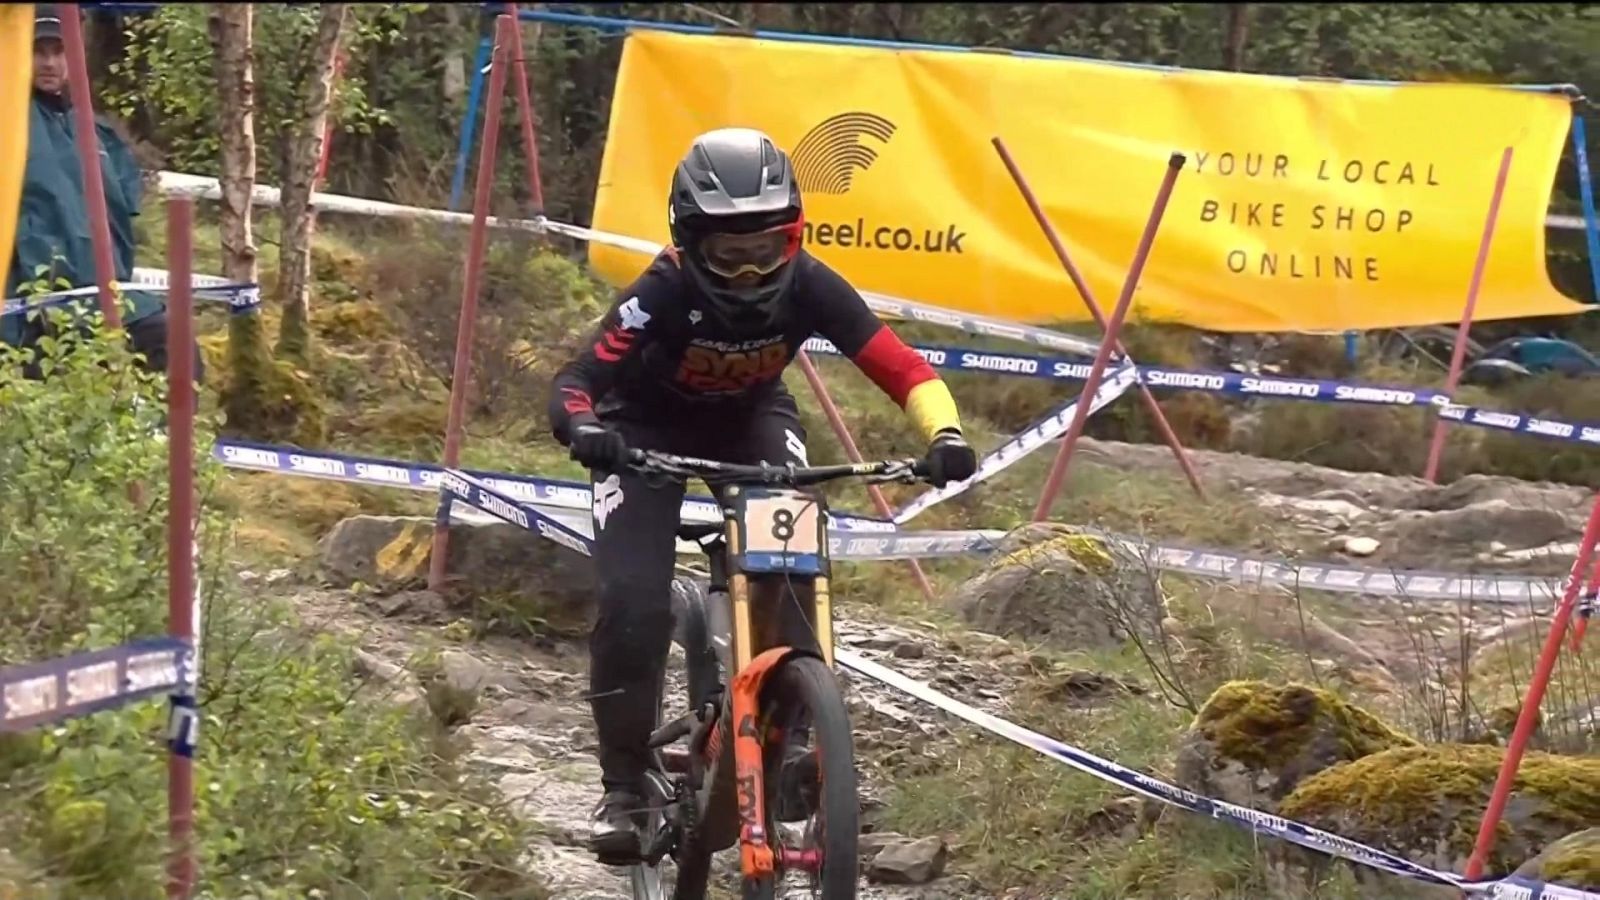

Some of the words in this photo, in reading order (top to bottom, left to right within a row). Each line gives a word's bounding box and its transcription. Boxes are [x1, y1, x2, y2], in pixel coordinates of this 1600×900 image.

[1195, 152, 1290, 178] YOUR
[1317, 159, 1440, 187] LOCAL
[1200, 200, 1285, 227] BIKE
[1311, 204, 1413, 232] SHOP
[1227, 250, 1379, 281] ONLINE
[961, 353, 1039, 374] SHIMANO
[1147, 370, 1226, 390] SHIMANO
[1240, 377, 1320, 398] SHIMANO
[478, 490, 529, 529] SHIMANO
[771, 508, 795, 541] 8
